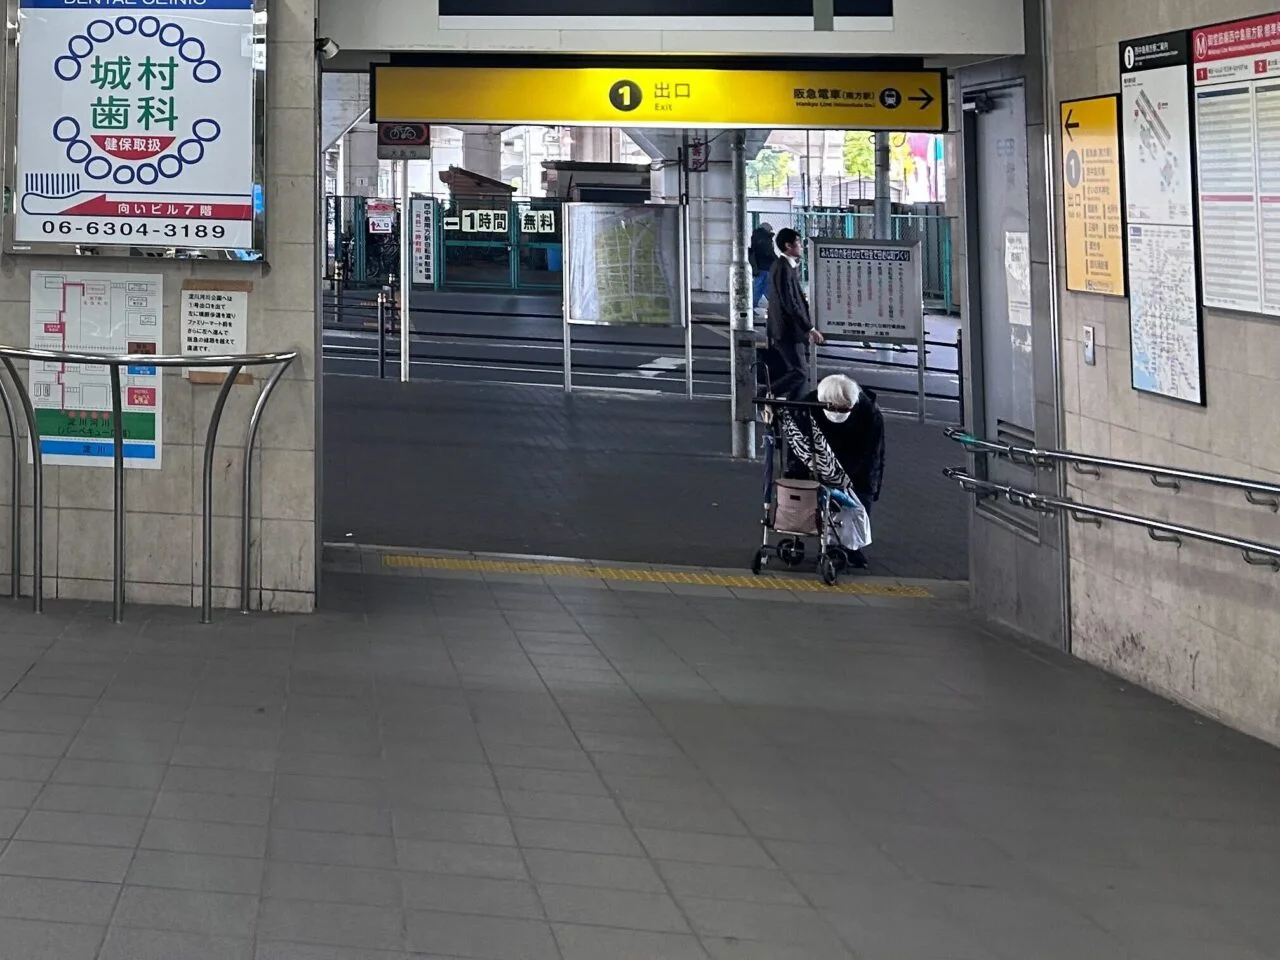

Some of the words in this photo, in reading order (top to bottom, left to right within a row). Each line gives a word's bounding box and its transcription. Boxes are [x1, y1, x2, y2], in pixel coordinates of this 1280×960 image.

[90, 54, 179, 91] 城村
[618, 85, 631, 106] 1
[654, 82, 690, 98] 出口
[90, 96, 179, 131] 歯科
[654, 103, 673, 111] Exit
[104, 137, 161, 152] 健保取扱
[42, 220, 226, 239] 06-6304-3189
[464, 212, 506, 231] 1時間
[523, 213, 553, 231] 無料
